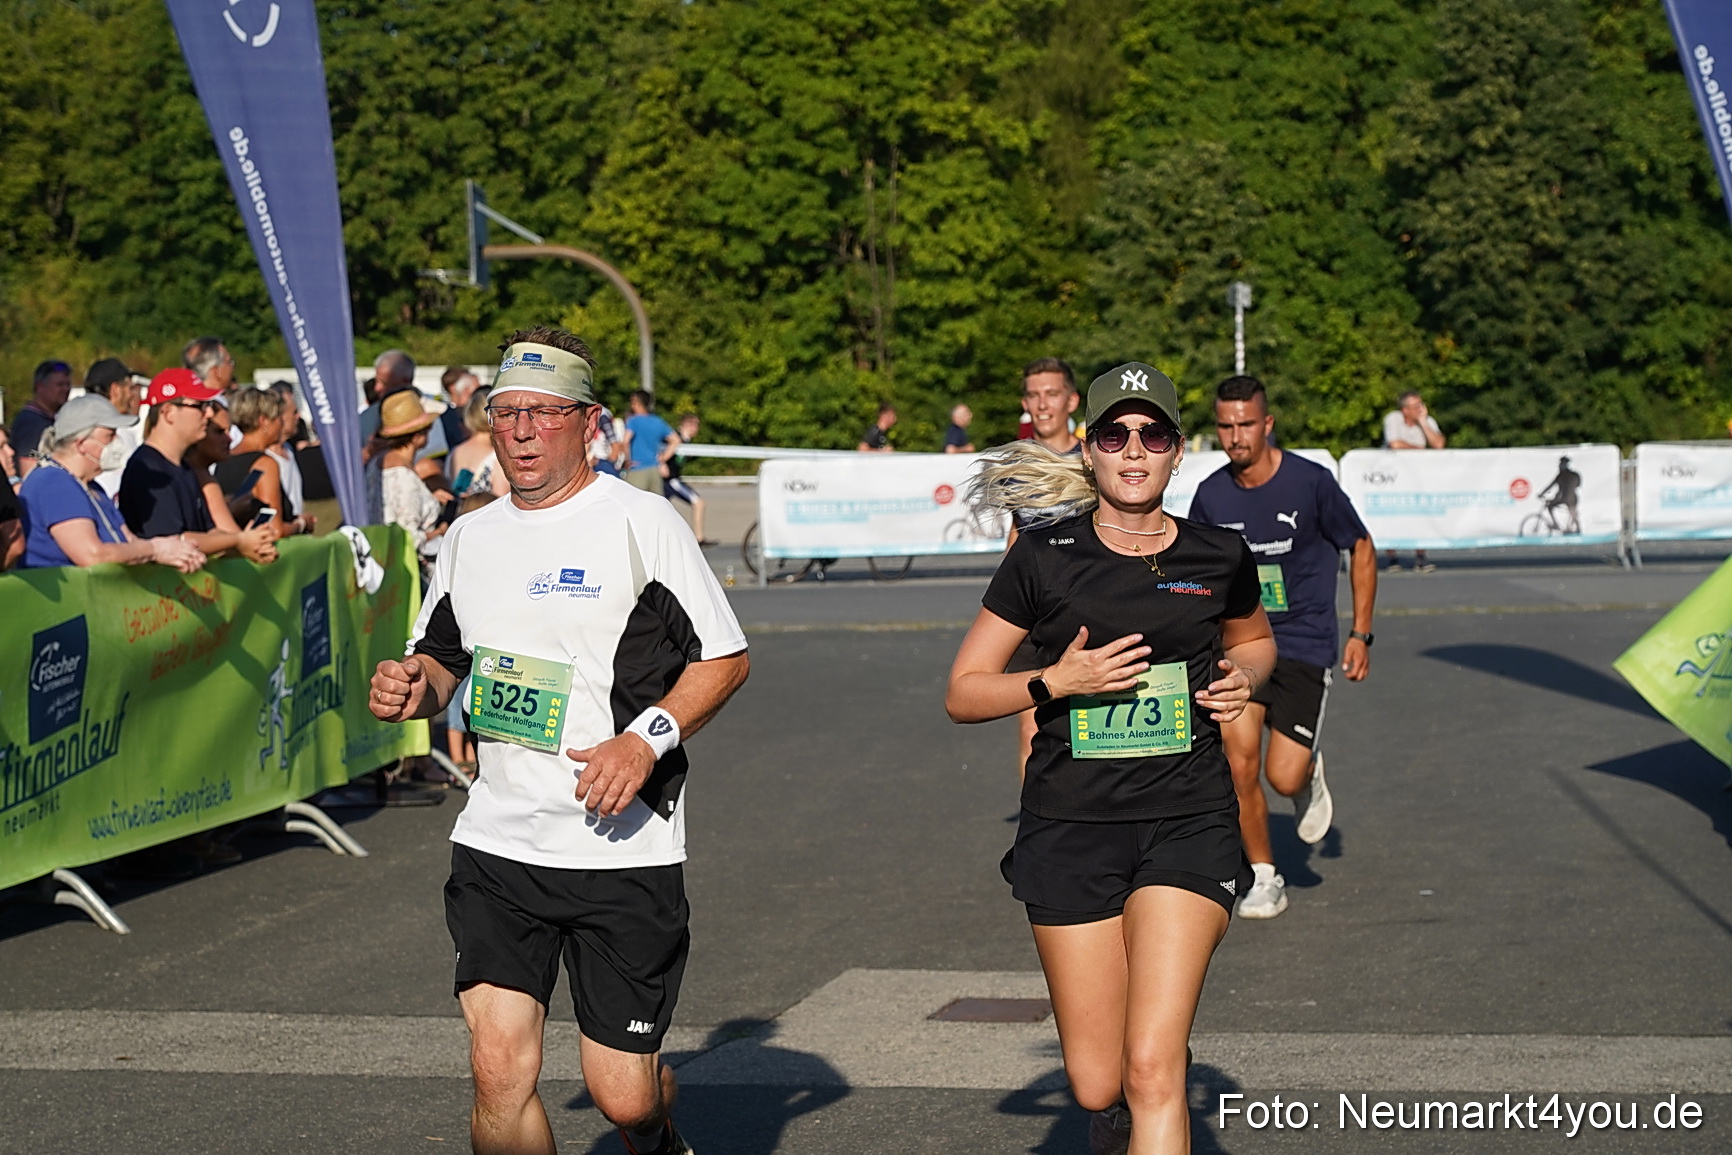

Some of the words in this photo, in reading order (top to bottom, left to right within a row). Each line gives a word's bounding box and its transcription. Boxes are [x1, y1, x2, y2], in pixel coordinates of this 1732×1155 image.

[1058, 537, 1075, 545] JAKO
[551, 584, 602, 593] Firmenlauf
[1157, 580, 1203, 590] autoladen
[1170, 587, 1212, 596] neumarkt
[493, 667, 524, 677] Firmenlauf
[474, 685, 484, 716] RUN
[490, 681, 540, 716] 525
[1100, 697, 1162, 728] 773
[480, 708, 512, 722] Federhofer
[512, 716, 546, 731] Wolfgang
[545, 697, 562, 738] 2022
[1077, 709, 1089, 740] RUN
[1174, 699, 1186, 740] 2022
[1088, 731, 1126, 740] Bohnes
[1128, 727, 1176, 739] Alexandra
[3, 691, 130, 808] firmenlauf
[4, 792, 60, 838] neumarkt
